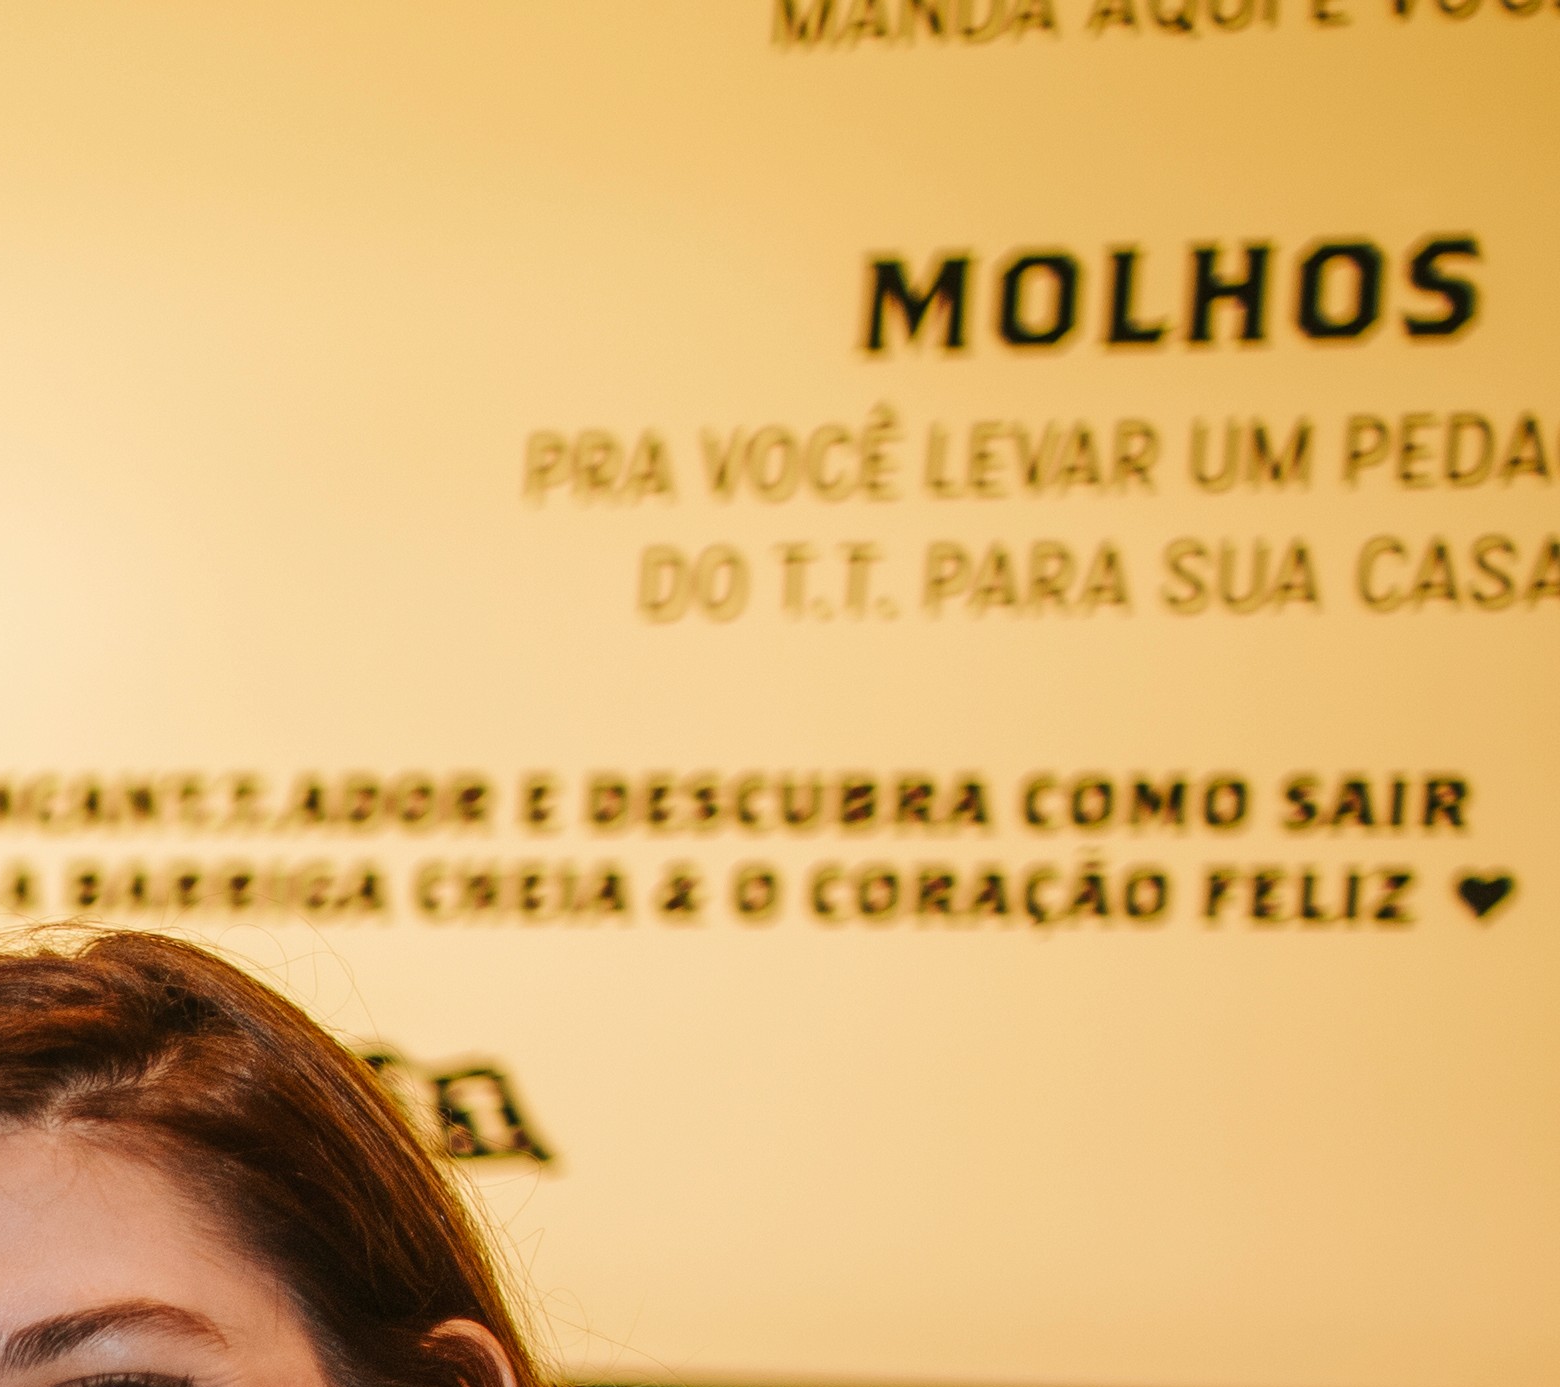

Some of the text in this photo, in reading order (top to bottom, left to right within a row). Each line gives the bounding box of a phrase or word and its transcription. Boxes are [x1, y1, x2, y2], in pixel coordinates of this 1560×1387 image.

[860, 234, 1488, 356] MOLHOS
[523, 403, 1560, 504] PRA VOCÊ LEVAR UM PEDA
[636, 533, 1560, 626] DO T.T. PARA SUA CASA
[518, 771, 558, 836] E
[583, 770, 996, 837] DESCUBRA
[1017, 769, 1256, 837] COMO
[1278, 769, 1476, 837] SAIR
[62, 860, 392, 926] BARRIGA
[412, 860, 634, 926] CHEIA
[727, 860, 786, 926] O
[804, 849, 1177, 941] CORAÇÃO
[1198, 862, 1421, 931] FELIZ
